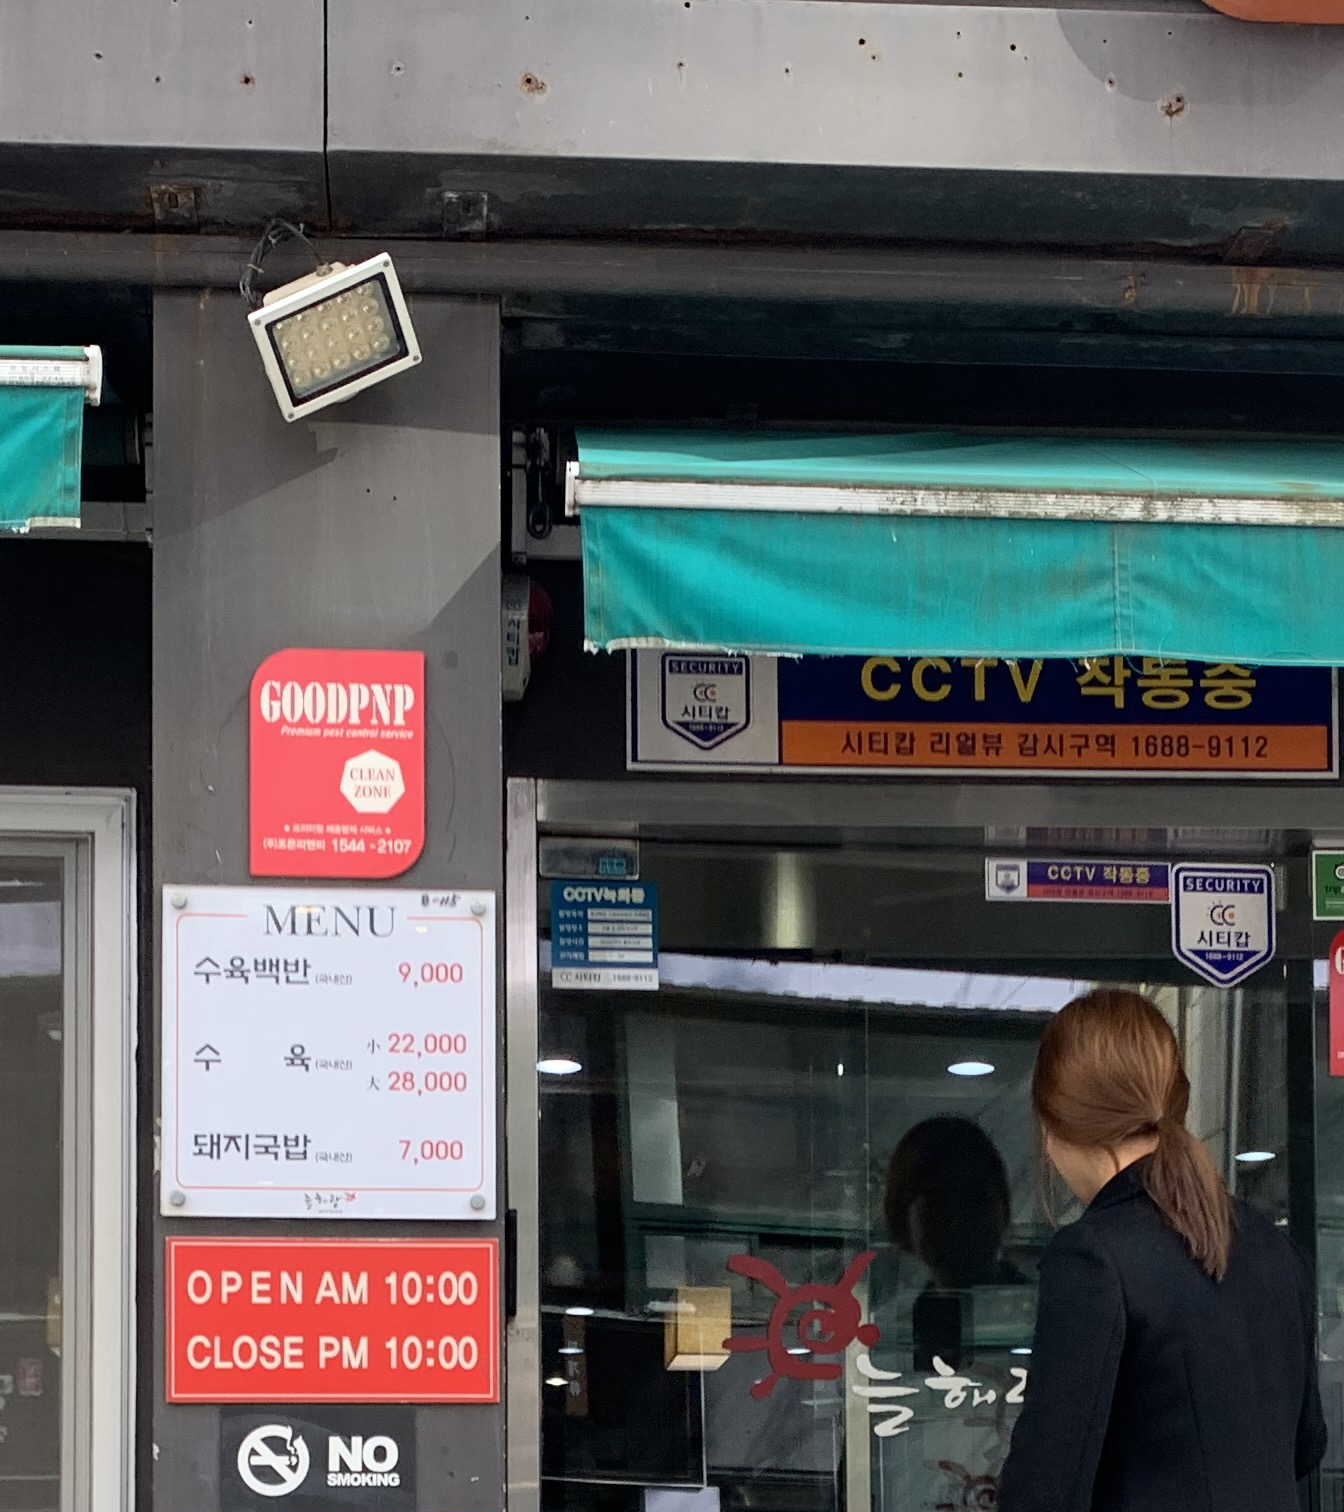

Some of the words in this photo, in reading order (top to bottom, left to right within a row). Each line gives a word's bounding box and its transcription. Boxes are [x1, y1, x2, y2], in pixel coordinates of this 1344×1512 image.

[670, 660, 740, 674] SECURITY
[861, 656, 1043, 703] CCTV
[1076, 656, 1257, 710] 작동중
[260, 680, 415, 727] GOODPNP
[681, 705, 730, 721] 시티캅
[281, 725, 321, 737] Premium
[323, 727, 344, 739] pest
[346, 728, 379, 739] control
[380, 729, 414, 740] service
[841, 731, 916, 757] 시티캅
[929, 731, 1004, 758] 리얼뷰
[1017, 732, 1117, 759] 감시구역
[1131, 734, 1269, 759] 1688-9112
[350, 767, 395, 782] CLEAN
[354, 785, 391, 799] ZONE
[1047, 865, 1096, 883] CCTV
[1186, 877, 1261, 893] SECURITY
[263, 903, 397, 938] MENU
[1197, 930, 1251, 949] 시티캅
[193, 956, 312, 986] 수육백반
[398, 962, 464, 988] 9,000
[366, 1039, 381, 1055] 小
[387, 1033, 467, 1058] 22,000
[387, 1071, 467, 1096] 28,000
[192, 1133, 312, 1162] 돼지국밥
[398, 1139, 464, 1165] 7,000
[187, 1269, 303, 1305] OPEN
[315, 1270, 369, 1305] AM
[384, 1270, 478, 1306] 10:00
[186, 1335, 305, 1370] CLOSE
[318, 1336, 369, 1369] PM
[384, 1336, 478, 1371] 10:00
[327, 1436, 399, 1472] NO
[326, 1472, 401, 1488] SMOKING
